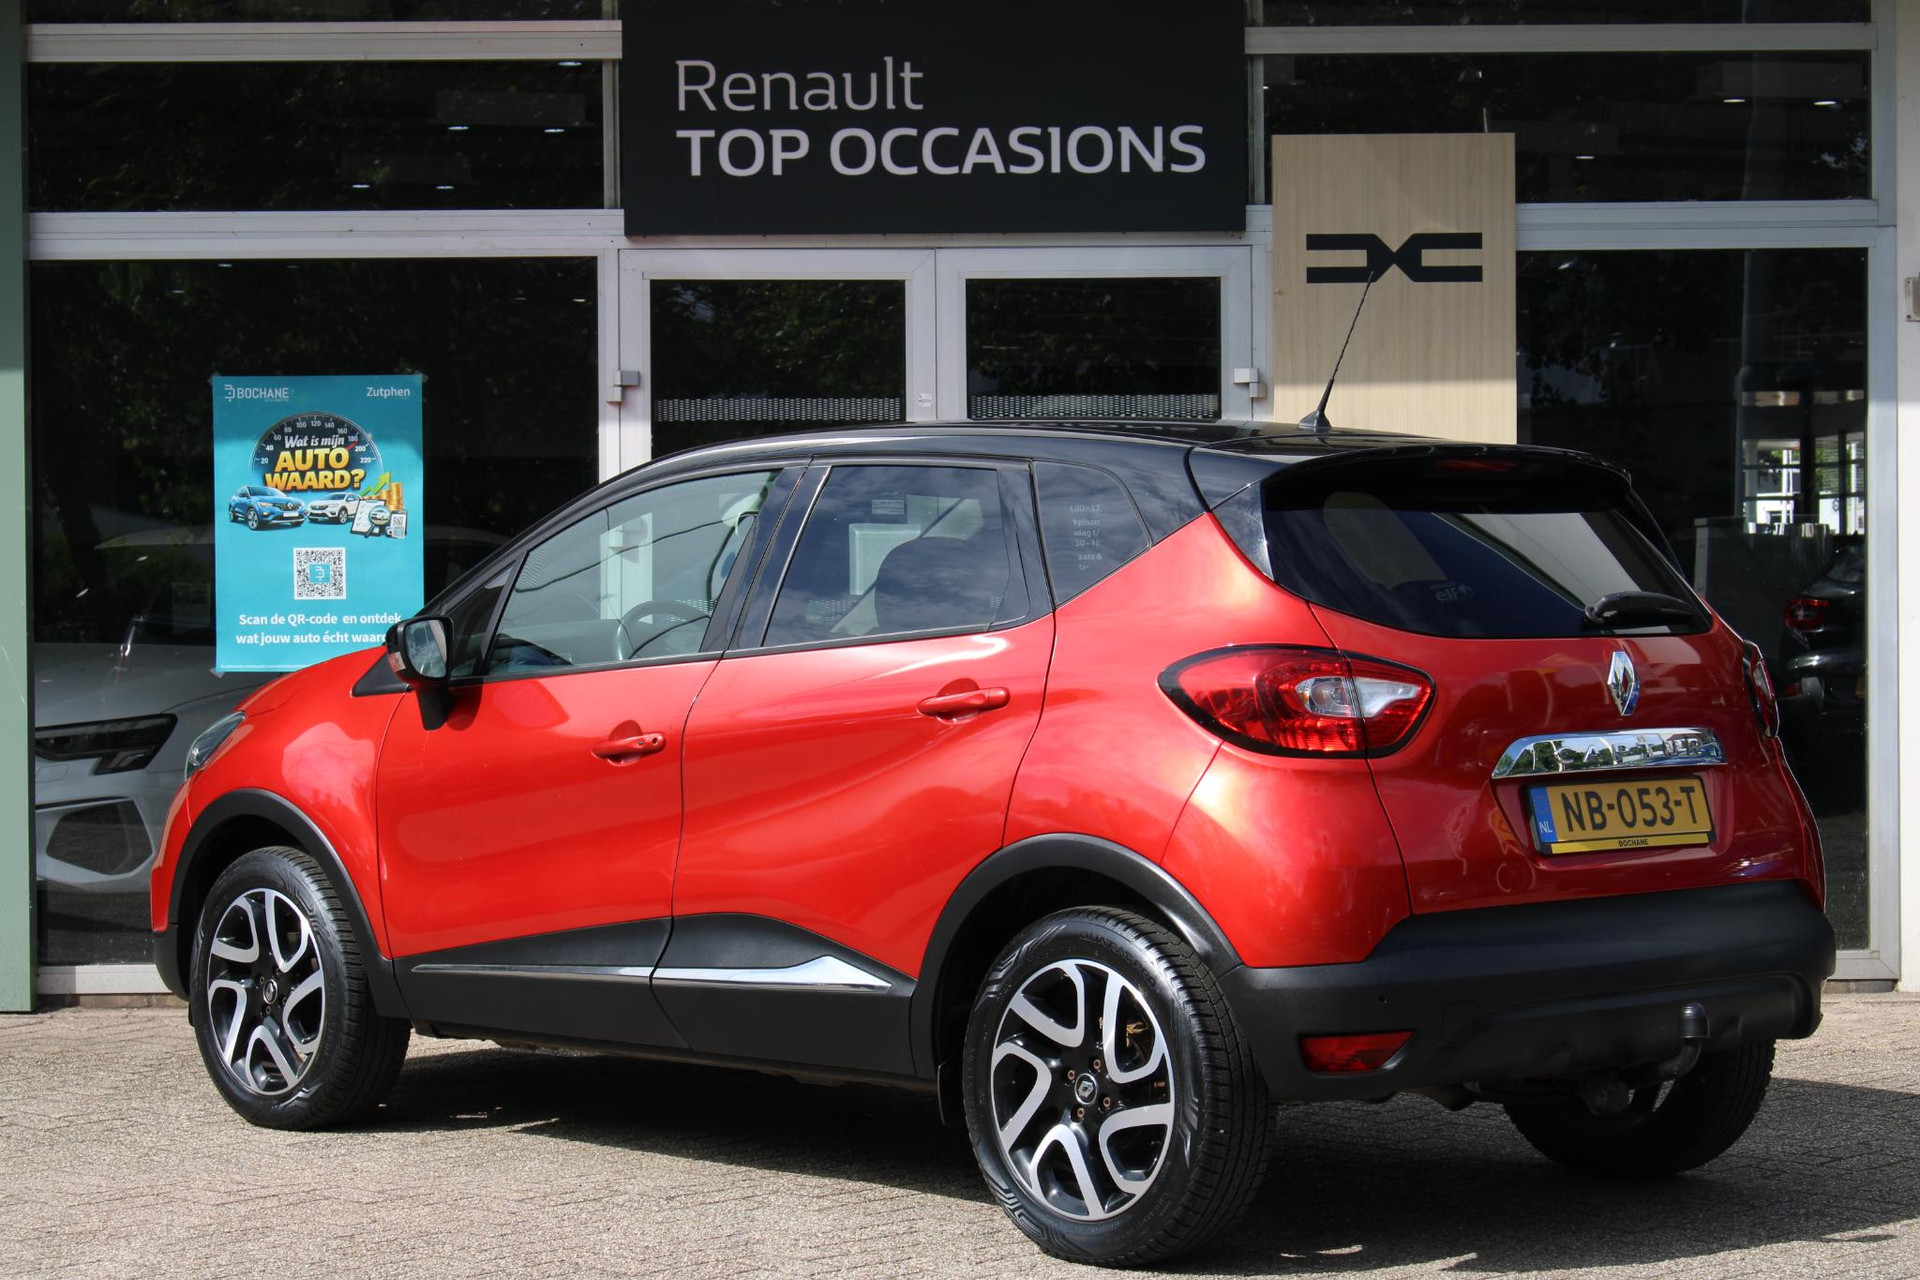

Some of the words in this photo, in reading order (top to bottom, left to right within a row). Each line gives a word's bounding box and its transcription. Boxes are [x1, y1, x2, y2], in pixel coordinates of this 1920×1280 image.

[675, 56, 924, 112] Renault
[676, 128, 810, 177] TOP
[829, 124, 1206, 177] OCCASIONS
[237, 387, 289, 399] BOCHANE
[366, 386, 410, 399] Zutphen
[284, 434, 309, 448] Wat
[311, 435, 321, 446] is
[321, 434, 345, 449] mijn
[274, 447, 350, 473] AUTO
[264, 469, 367, 491] WAARD?
[239, 614, 268, 625] Scan
[270, 613, 286, 625] de
[287, 613, 338, 627] QR-code
[342, 614, 358, 624] en
[359, 612, 402, 624] ontdek
[236, 633, 259, 644] wat
[259, 632, 291, 646] jouw
[293, 632, 320, 643] auto
[322, 631, 350, 643] écht
[1561, 786, 1698, 832] NB-053-T
[1538, 821, 1553, 834] NL
[1618, 838, 1650, 847] BOCHANE
